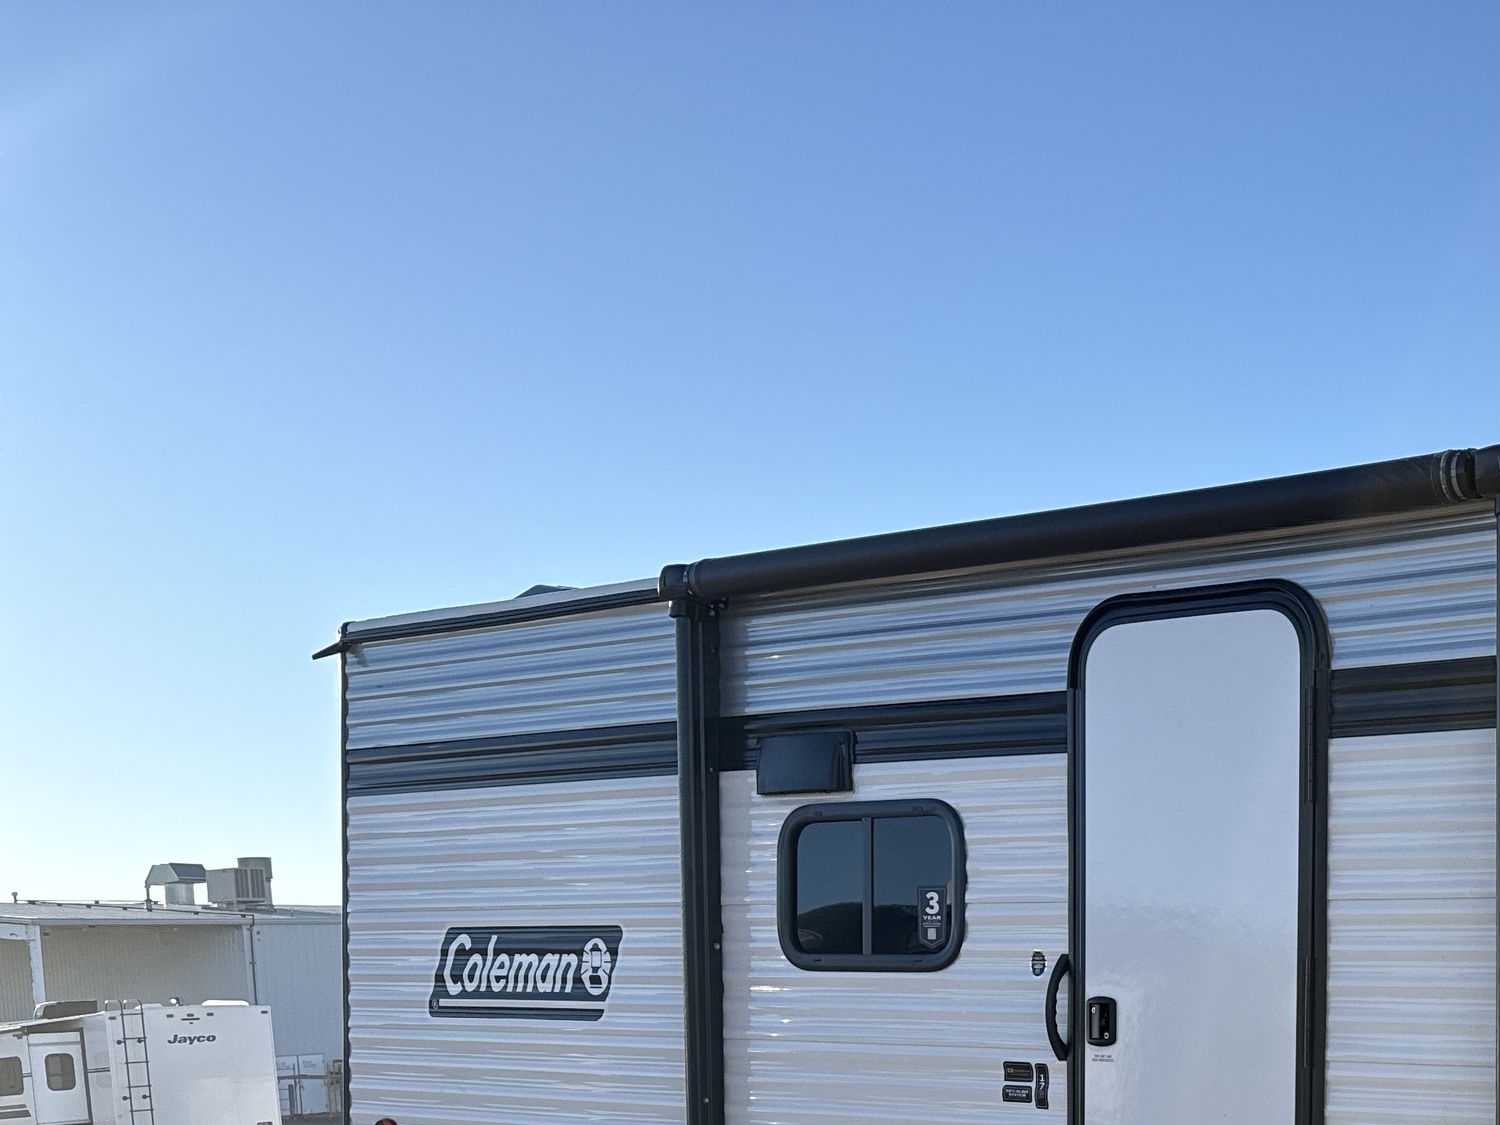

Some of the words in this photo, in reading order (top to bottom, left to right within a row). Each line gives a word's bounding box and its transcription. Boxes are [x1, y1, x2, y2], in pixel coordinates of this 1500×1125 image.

[925, 891, 940, 915] 3
[443, 933, 579, 996] Coleman
[167, 1034, 217, 1045] Jayco
